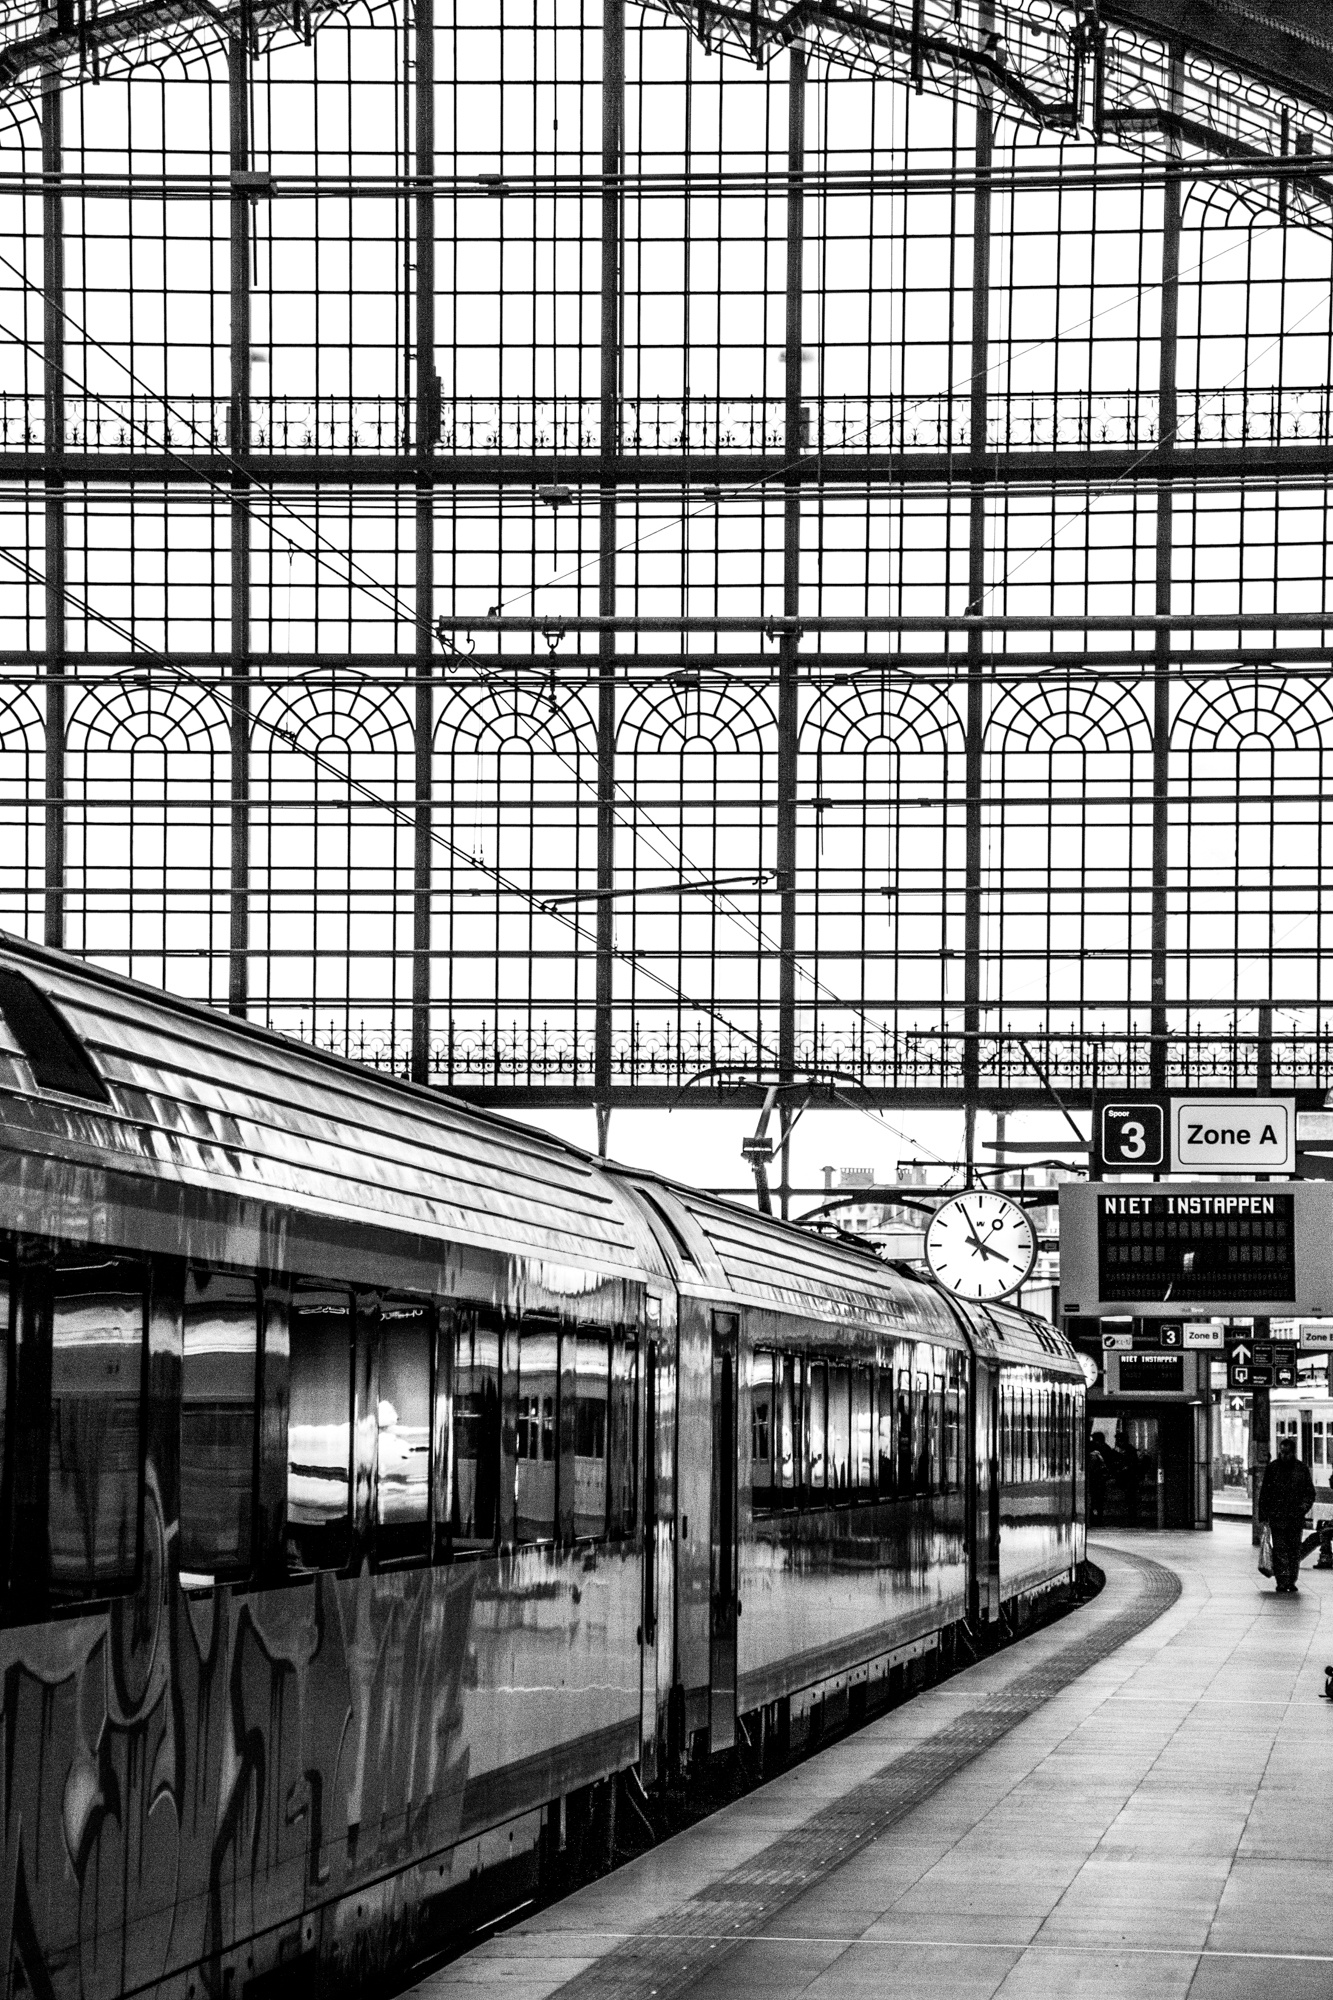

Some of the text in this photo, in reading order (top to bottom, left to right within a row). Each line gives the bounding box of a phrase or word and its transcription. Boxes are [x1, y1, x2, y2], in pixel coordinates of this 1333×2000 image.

[1108, 1110, 1130, 1118] Spoor
[1120, 1121, 1147, 1158] 3
[1187, 1124, 1278, 1145] Zone A
[1105, 1197, 1274, 1214] NIET INSTAPPEN
[1166, 1330, 1176, 1344] 3
[1189, 1332, 1219, 1340] Zone B
[1305, 1333, 1328, 1341] Zone
